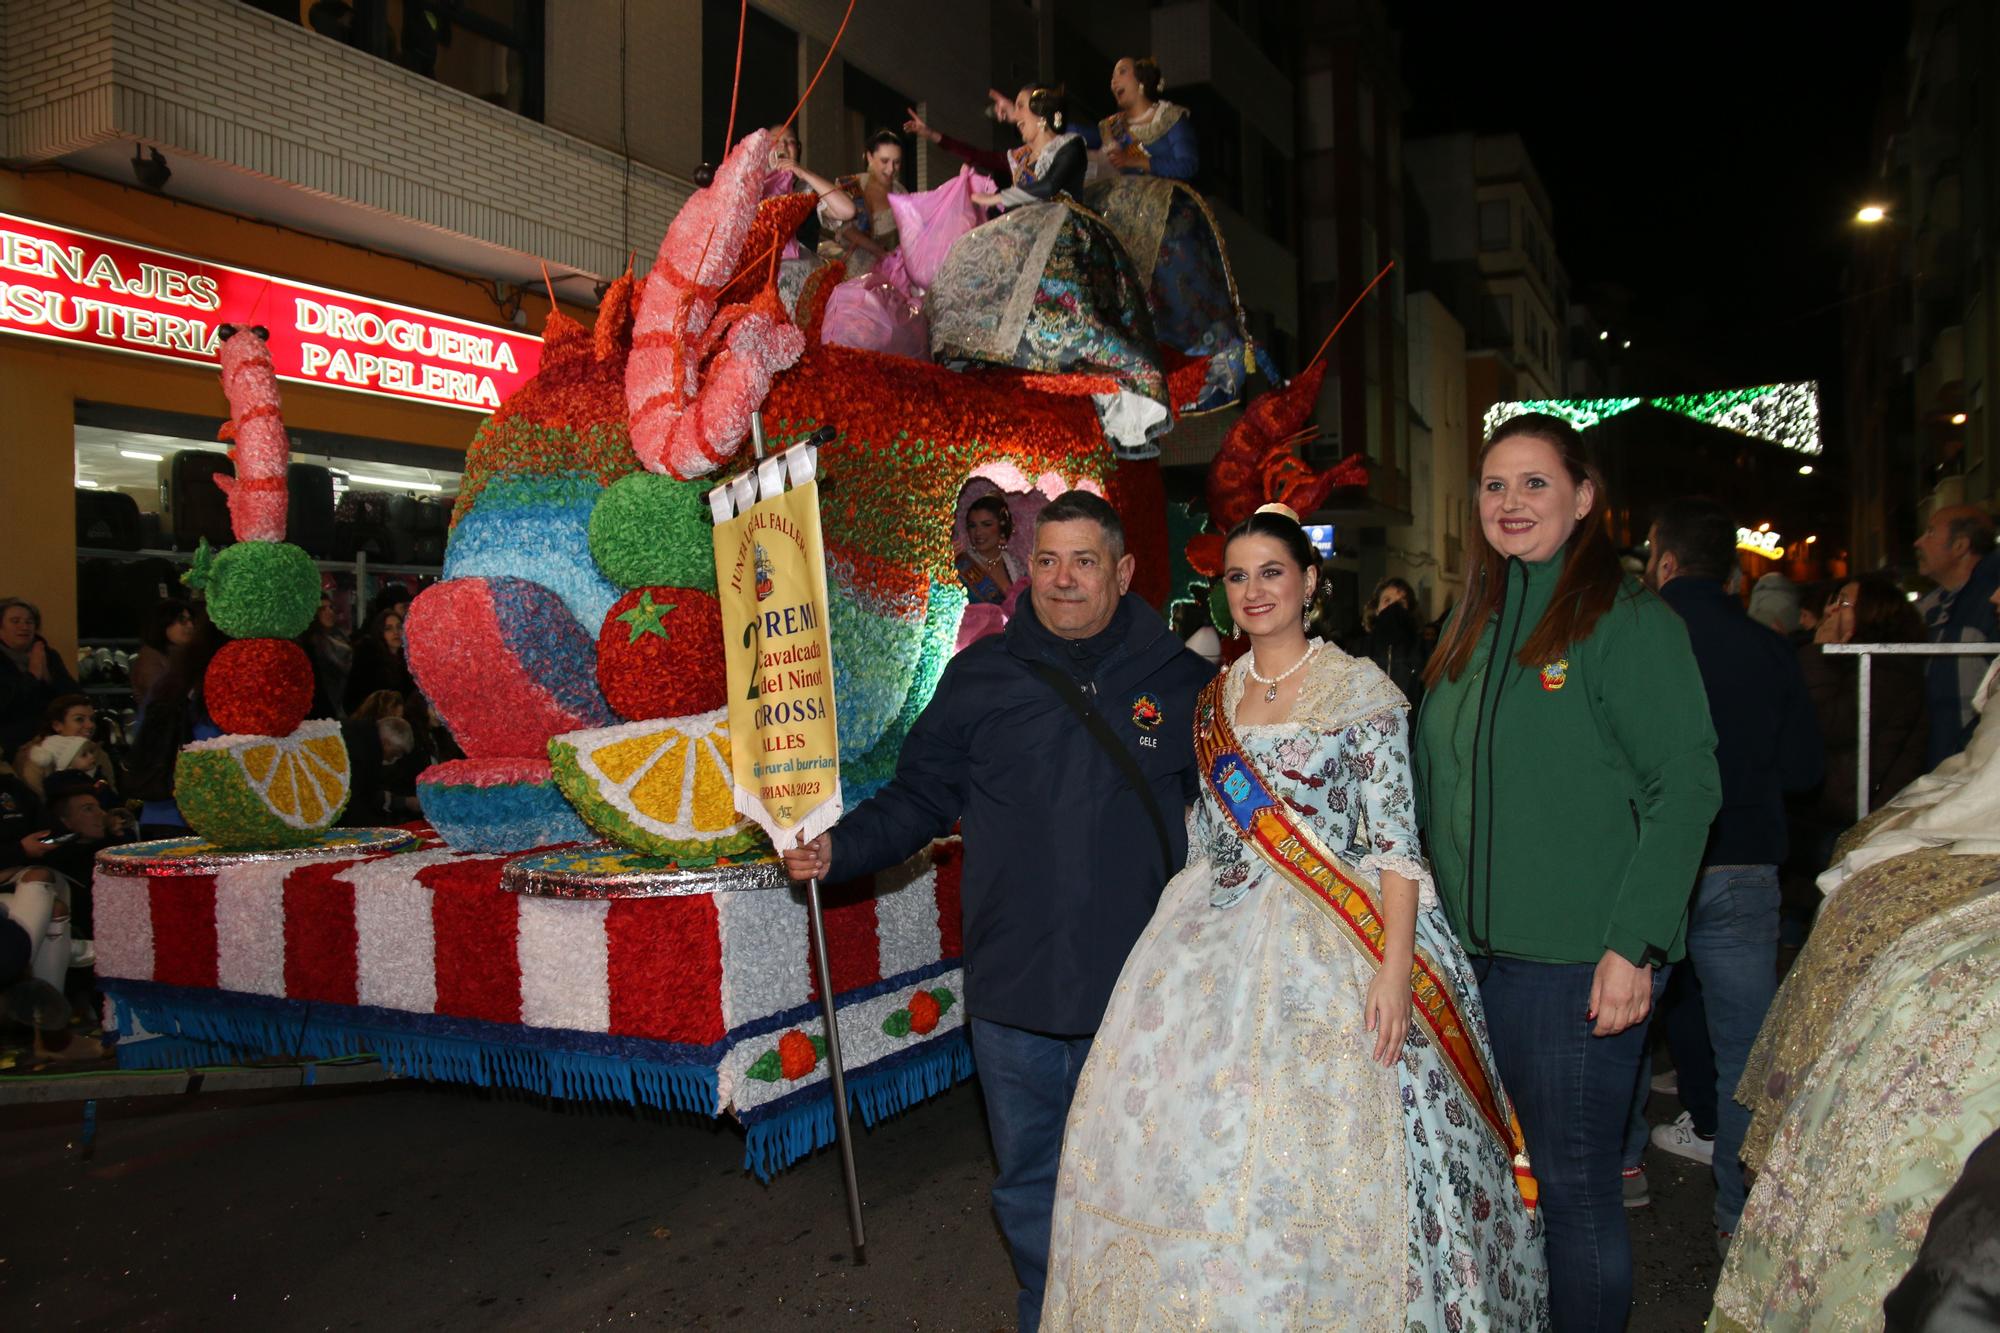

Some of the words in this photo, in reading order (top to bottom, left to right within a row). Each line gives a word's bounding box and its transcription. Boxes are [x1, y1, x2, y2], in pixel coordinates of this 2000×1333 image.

[294, 298, 519, 374] DROGUERIA
[301, 342, 501, 408] PAPELERIA
[743, 512, 767, 545] LAL
[769, 512, 809, 563] FALLER
[761, 672, 783, 695] del
[788, 666, 823, 691] Ninot
[1139, 735, 1158, 748] CELE
[764, 758, 794, 775] rural
[760, 784, 795, 801] RIANA
[796, 781, 821, 796] 2023
